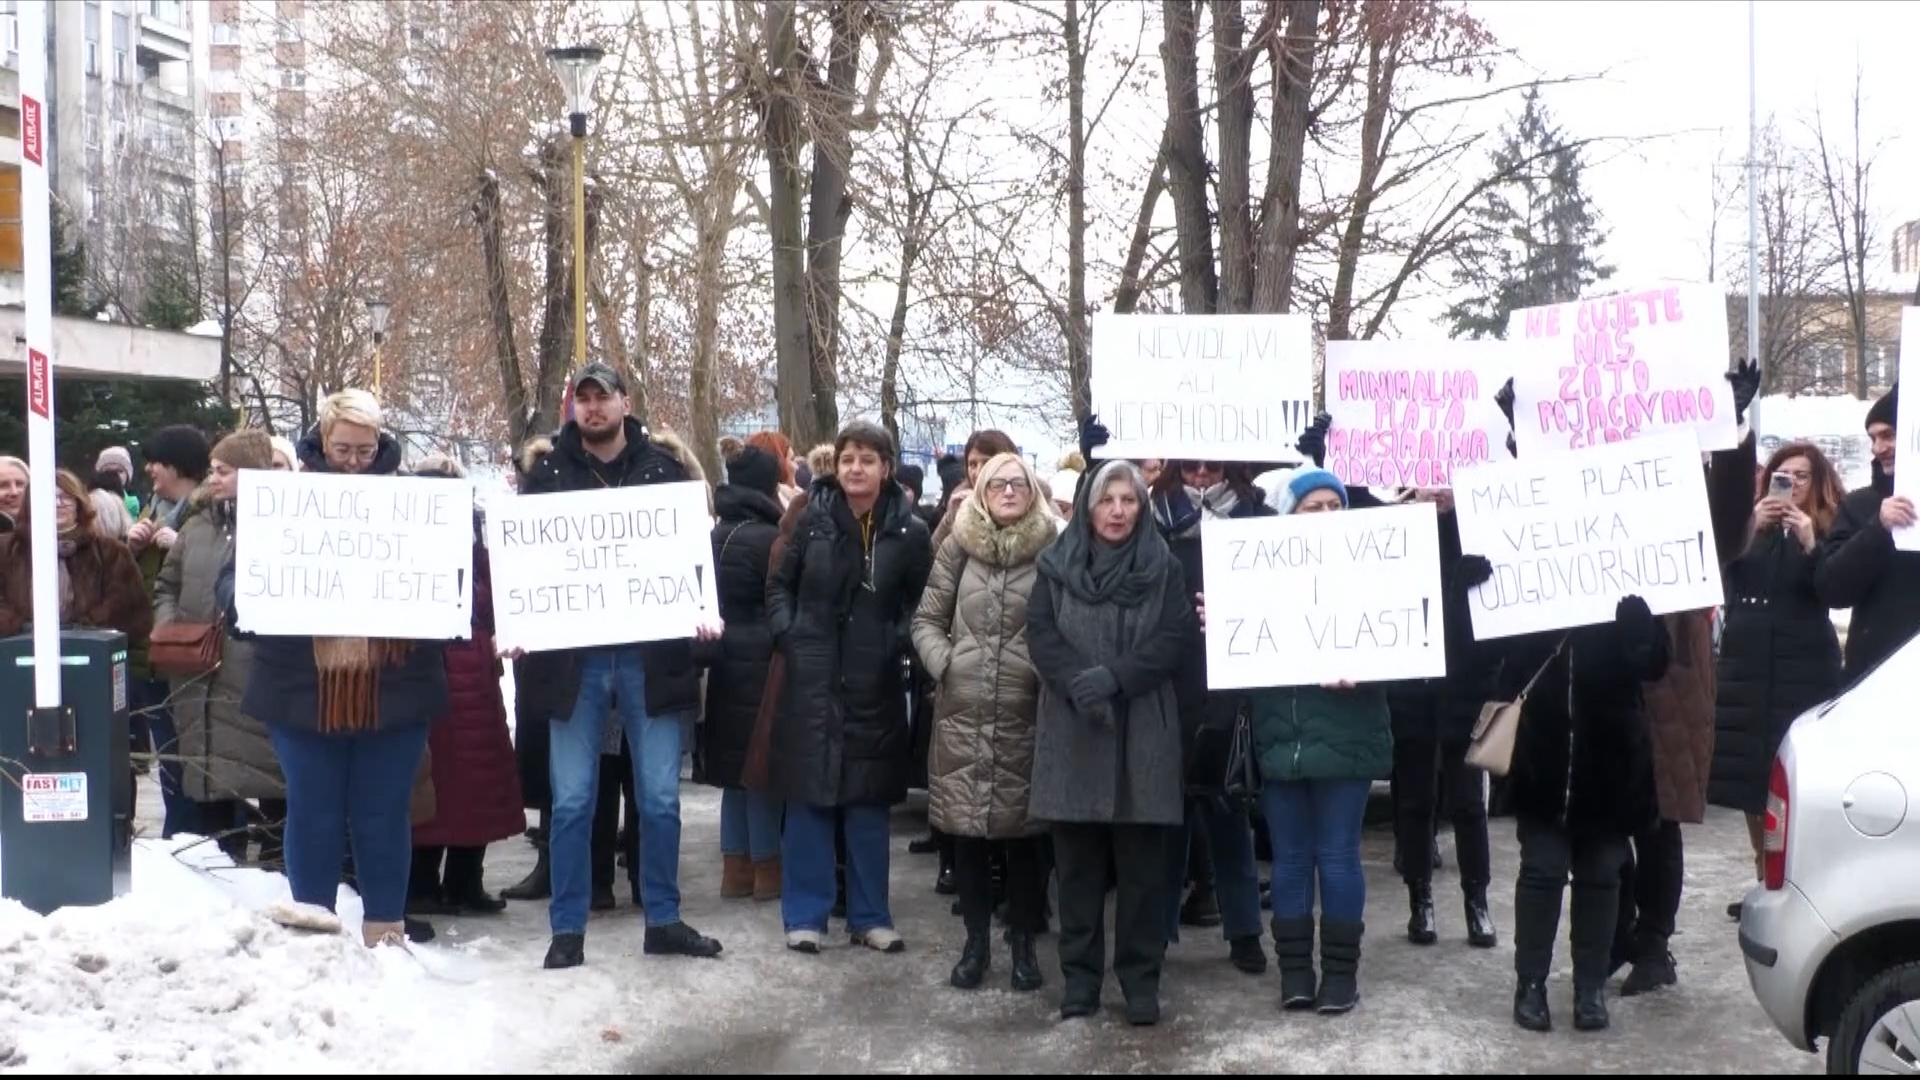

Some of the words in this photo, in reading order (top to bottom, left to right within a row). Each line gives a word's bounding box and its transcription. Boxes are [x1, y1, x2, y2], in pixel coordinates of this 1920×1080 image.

[1525, 306, 1560, 339] NE
[1574, 328, 1634, 365] NAS
[1177, 372, 1215, 394] ALI
[1339, 369, 1479, 400] MINIMALNA
[1559, 360, 1649, 401] ZATO
[1375, 400, 1465, 430] PLATA
[1329, 428, 1489, 461] MAKSIMALNA
[253, 486, 370, 524] DIJALOG
[393, 492, 449, 525] NIJE
[1472, 477, 1549, 514] MALE
[501, 507, 678, 547] RUKOVODIOCI
[1503, 512, 1630, 551] VELIKA
[1228, 533, 1323, 571] ZAKON
[1479, 530, 1708, 612] ODGOVORNOST!
[372, 568, 465, 609] JESTE!
[509, 583, 606, 615] SISTEM
[628, 564, 706, 611] PADA!
[1226, 616, 1279, 657] ZA
[1305, 597, 1429, 650] VLAST!
